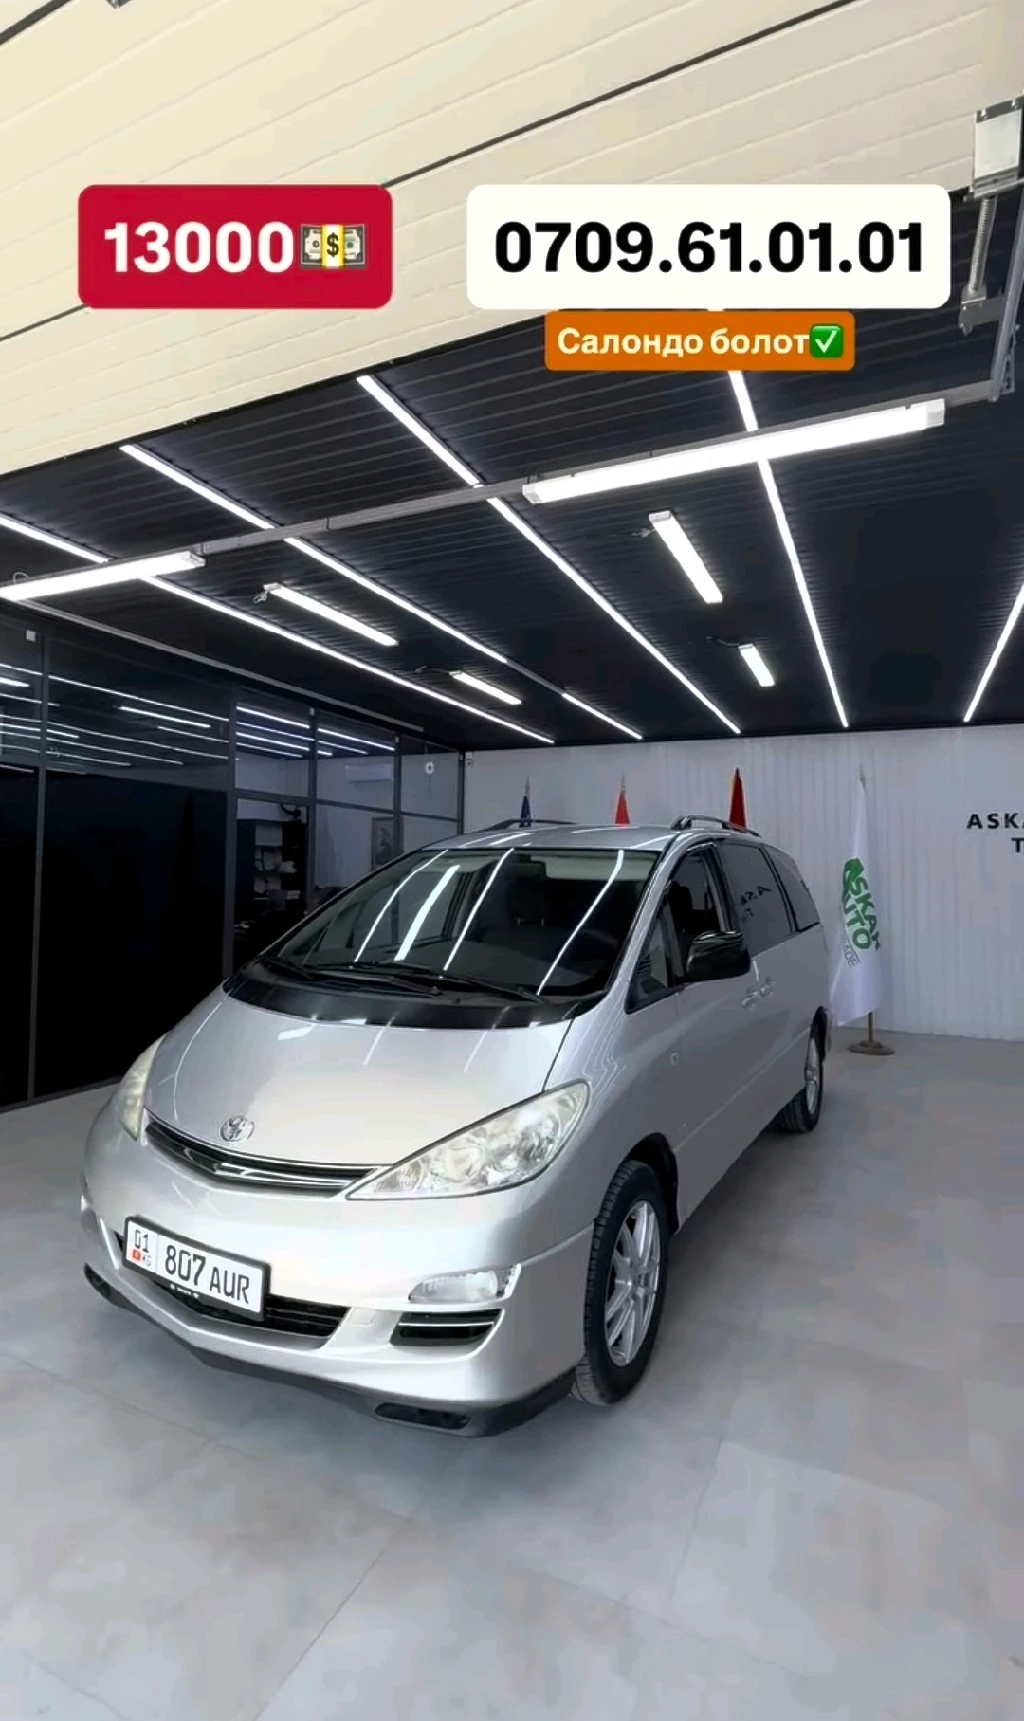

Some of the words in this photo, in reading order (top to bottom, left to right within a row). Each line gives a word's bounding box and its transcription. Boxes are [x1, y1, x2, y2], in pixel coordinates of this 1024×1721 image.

[966, 812, 1024, 830] ASK
[134, 1228, 149, 1254] 01
[164, 1244, 207, 1287] 807
[209, 1265, 250, 1305] AUR
